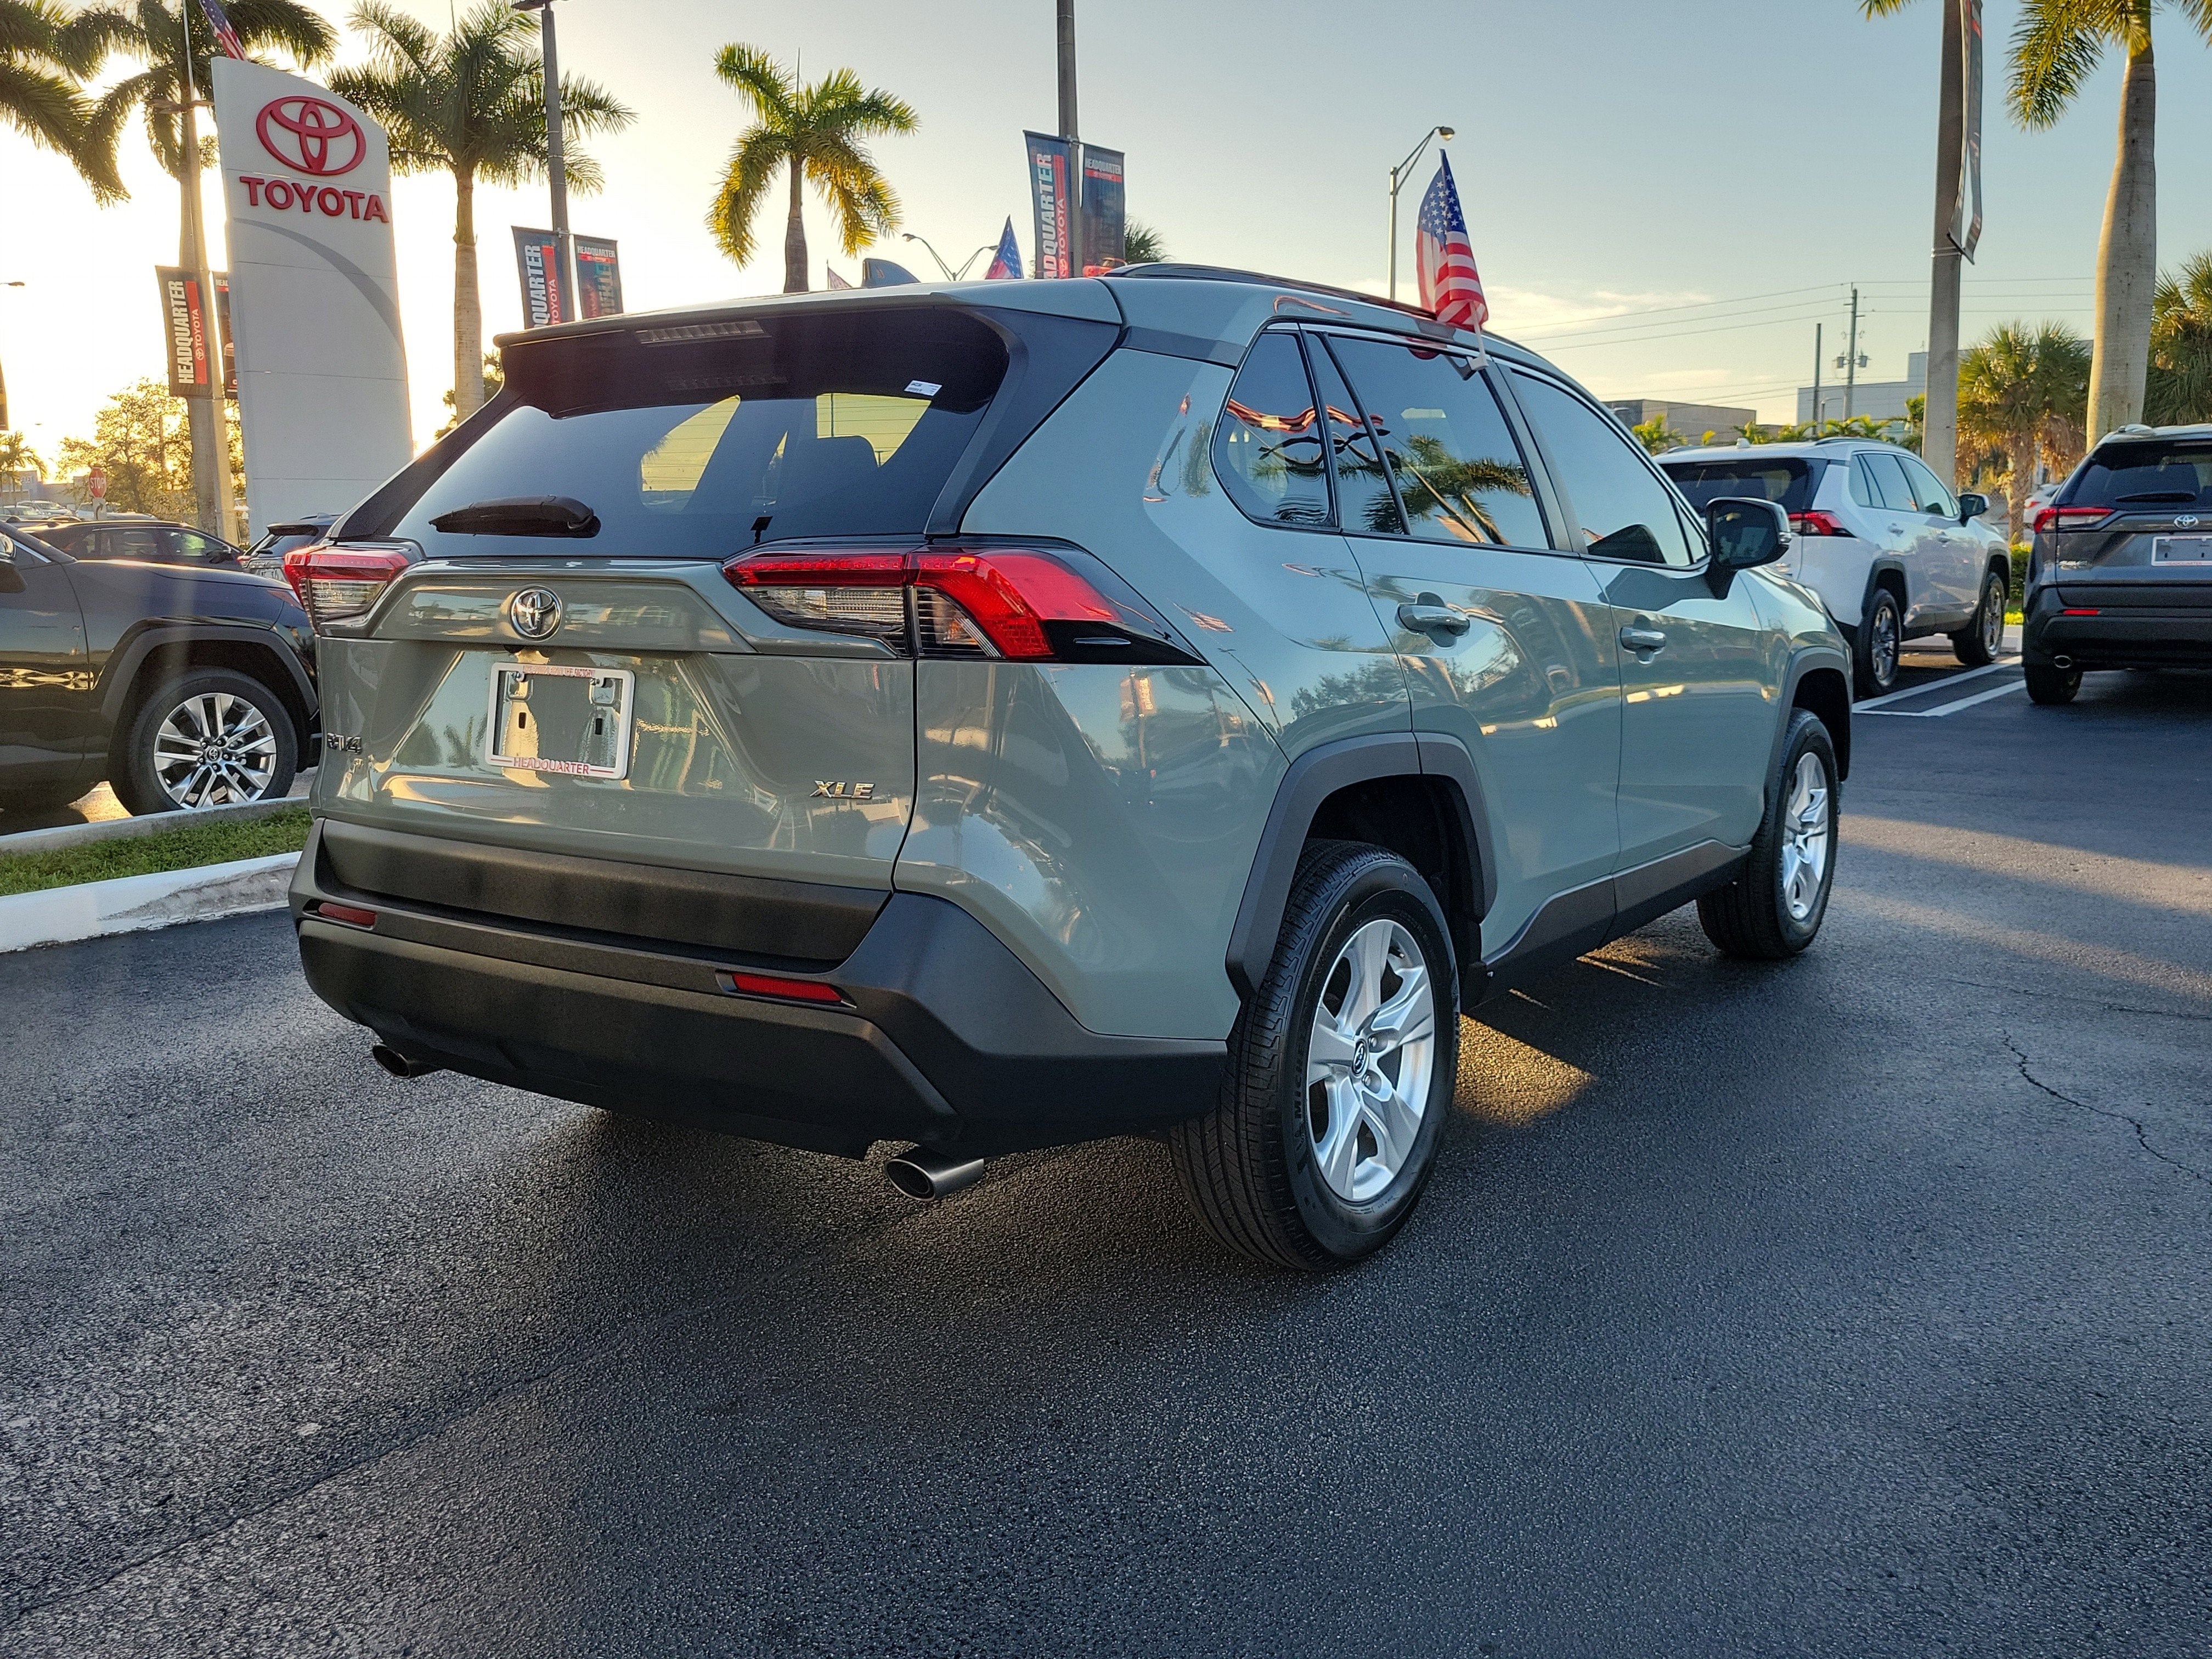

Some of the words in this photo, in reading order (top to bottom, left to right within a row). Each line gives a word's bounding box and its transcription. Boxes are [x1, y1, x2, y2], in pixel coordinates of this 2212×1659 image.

[239, 176, 390, 223] TOYOTA
[1056, 198, 1066, 256] TOYOTA
[168, 280, 195, 384] HEADQUARTER
[192, 308, 203, 347] TOYOTA
[90, 477, 105, 489] STOP
[514, 757, 589, 775] HEADQUARTER
[809, 780, 876, 799] XLE
